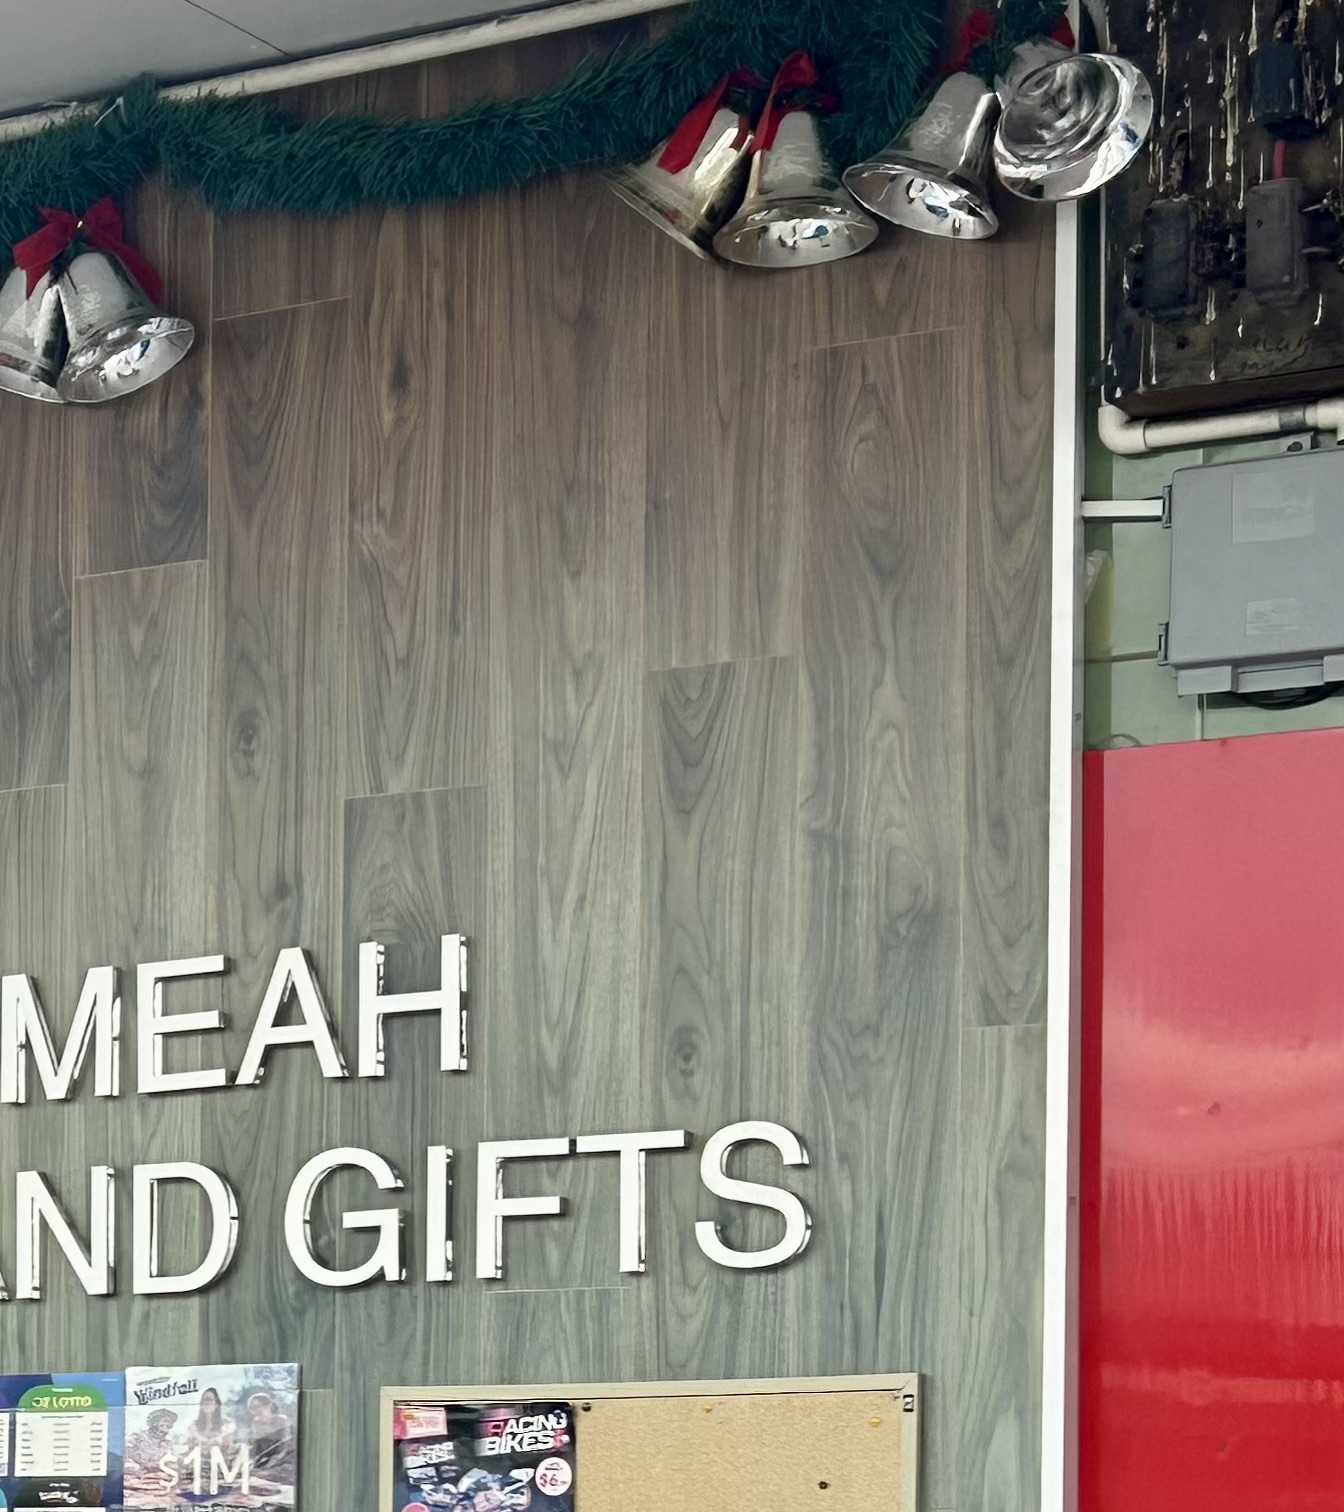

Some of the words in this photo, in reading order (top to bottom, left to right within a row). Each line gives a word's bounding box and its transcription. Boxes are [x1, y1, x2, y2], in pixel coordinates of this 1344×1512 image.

[284, 1119, 813, 1288] GIFTS
[158, 1442, 252, 1496] $1M
[478, 1429, 557, 1457] BIKES
